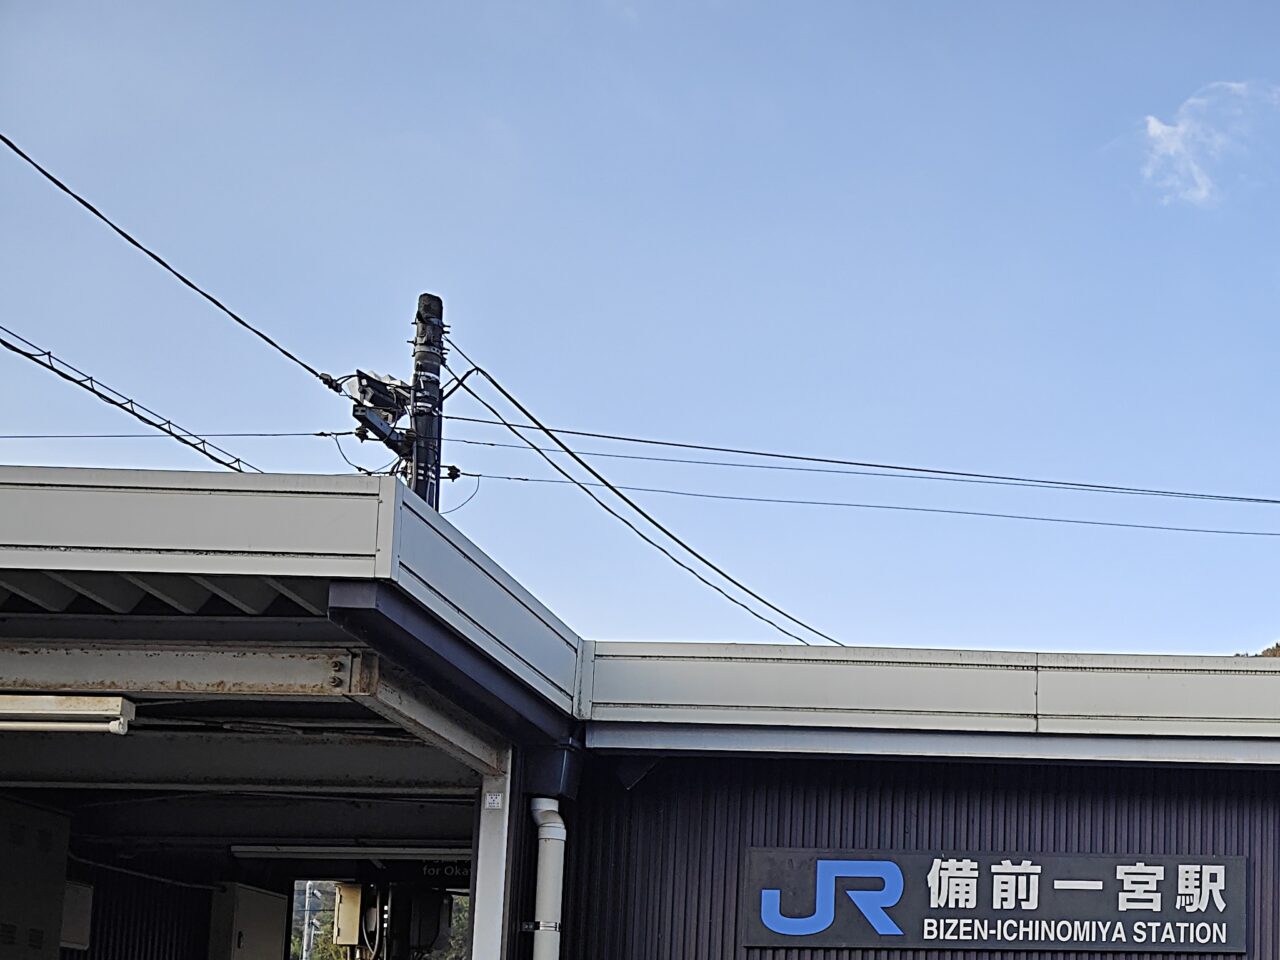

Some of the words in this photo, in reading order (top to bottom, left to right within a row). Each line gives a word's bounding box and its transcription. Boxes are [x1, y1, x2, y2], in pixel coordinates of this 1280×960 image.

[444, 865, 472, 876] Oka
[927, 857, 1227, 914] 備前一宮駅
[760, 859, 904, 936] JR
[923, 918, 1127, 943] BIZEN-ICHINOMIYA
[1132, 921, 1227, 944] STATION
